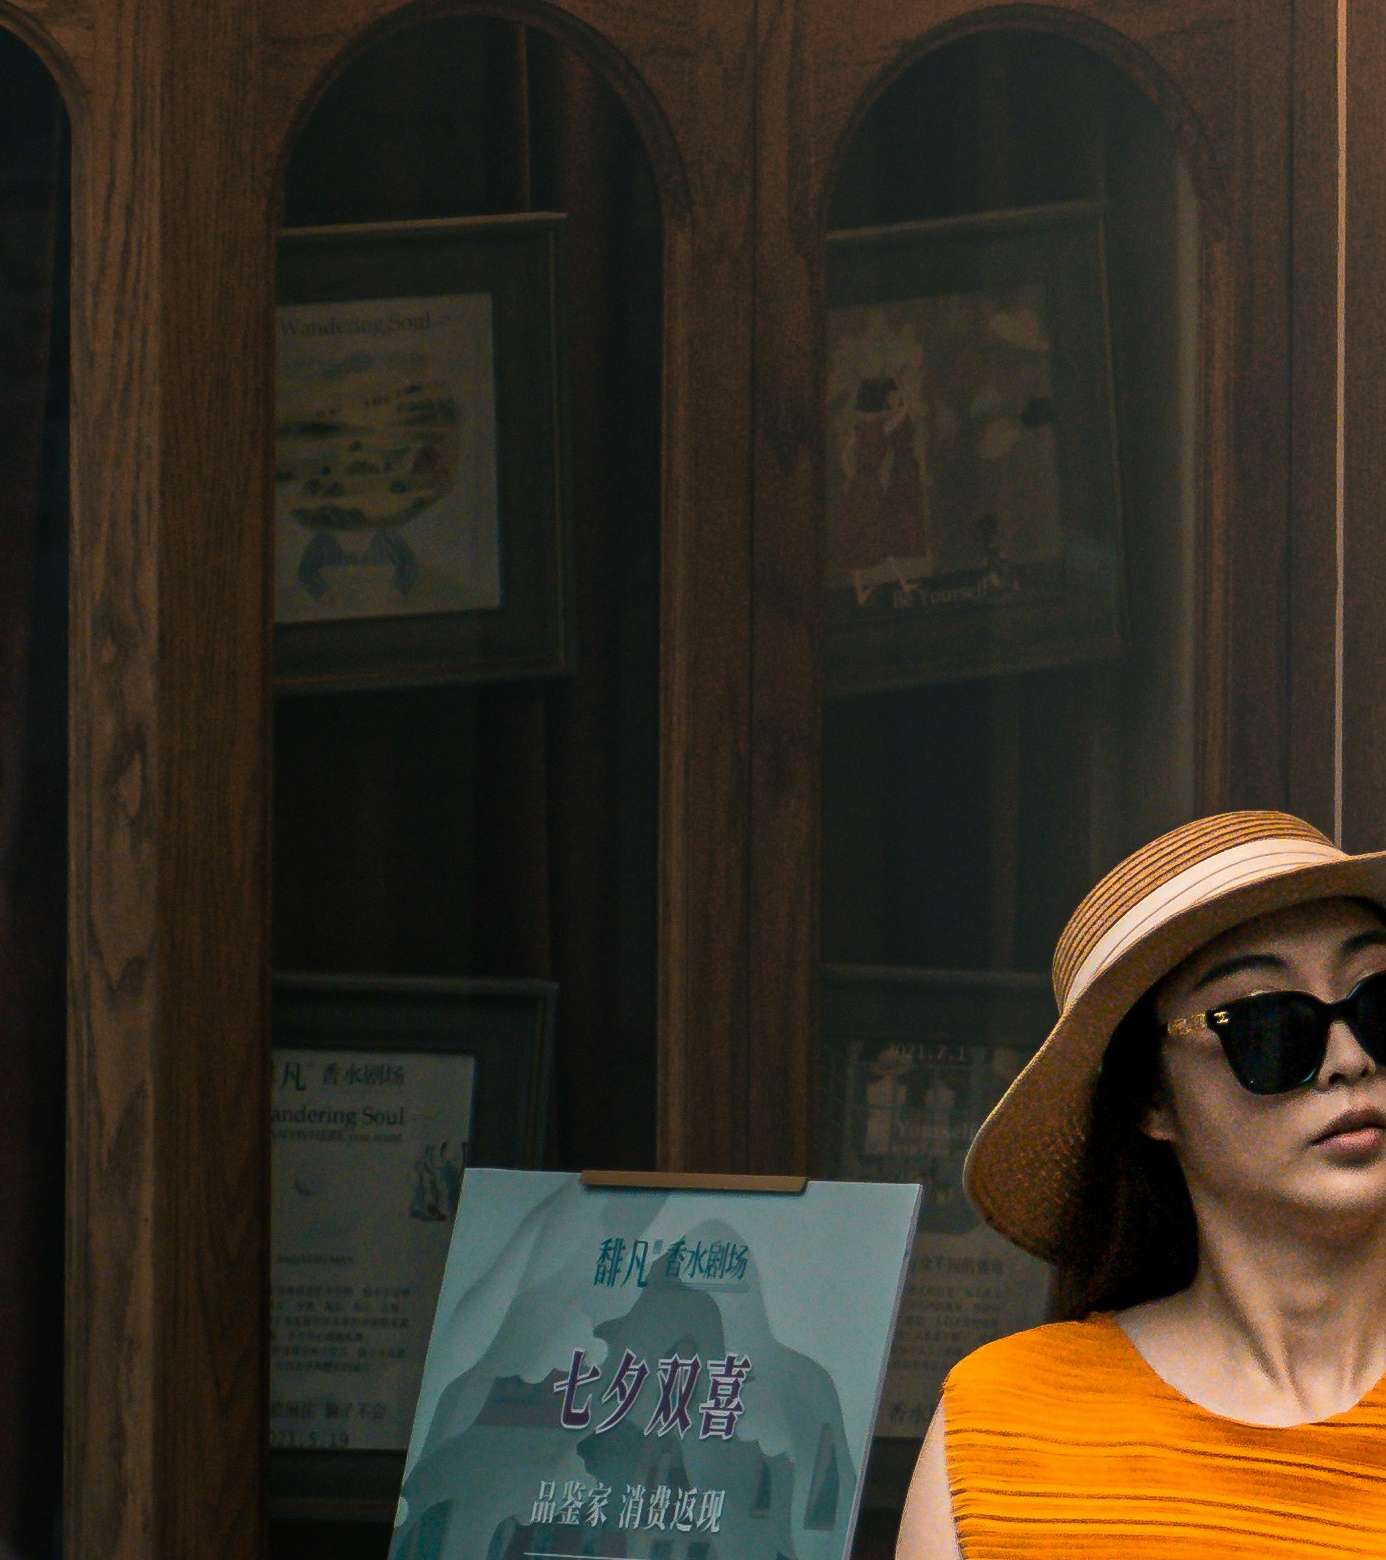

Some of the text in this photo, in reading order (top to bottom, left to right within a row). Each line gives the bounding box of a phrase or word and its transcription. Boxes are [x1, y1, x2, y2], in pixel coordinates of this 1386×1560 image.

[280, 311, 431, 339] Wandering Soul
[322, 1061, 406, 1087] 香水剧场
[271, 1103, 406, 1130] andering Soul
[666, 1236, 749, 1281] 香水剧场
[553, 1348, 753, 1442] 七夕双喜
[889, 1401, 935, 1426] 香水
[529, 1479, 727, 1534] 品鉴家 消费返现
